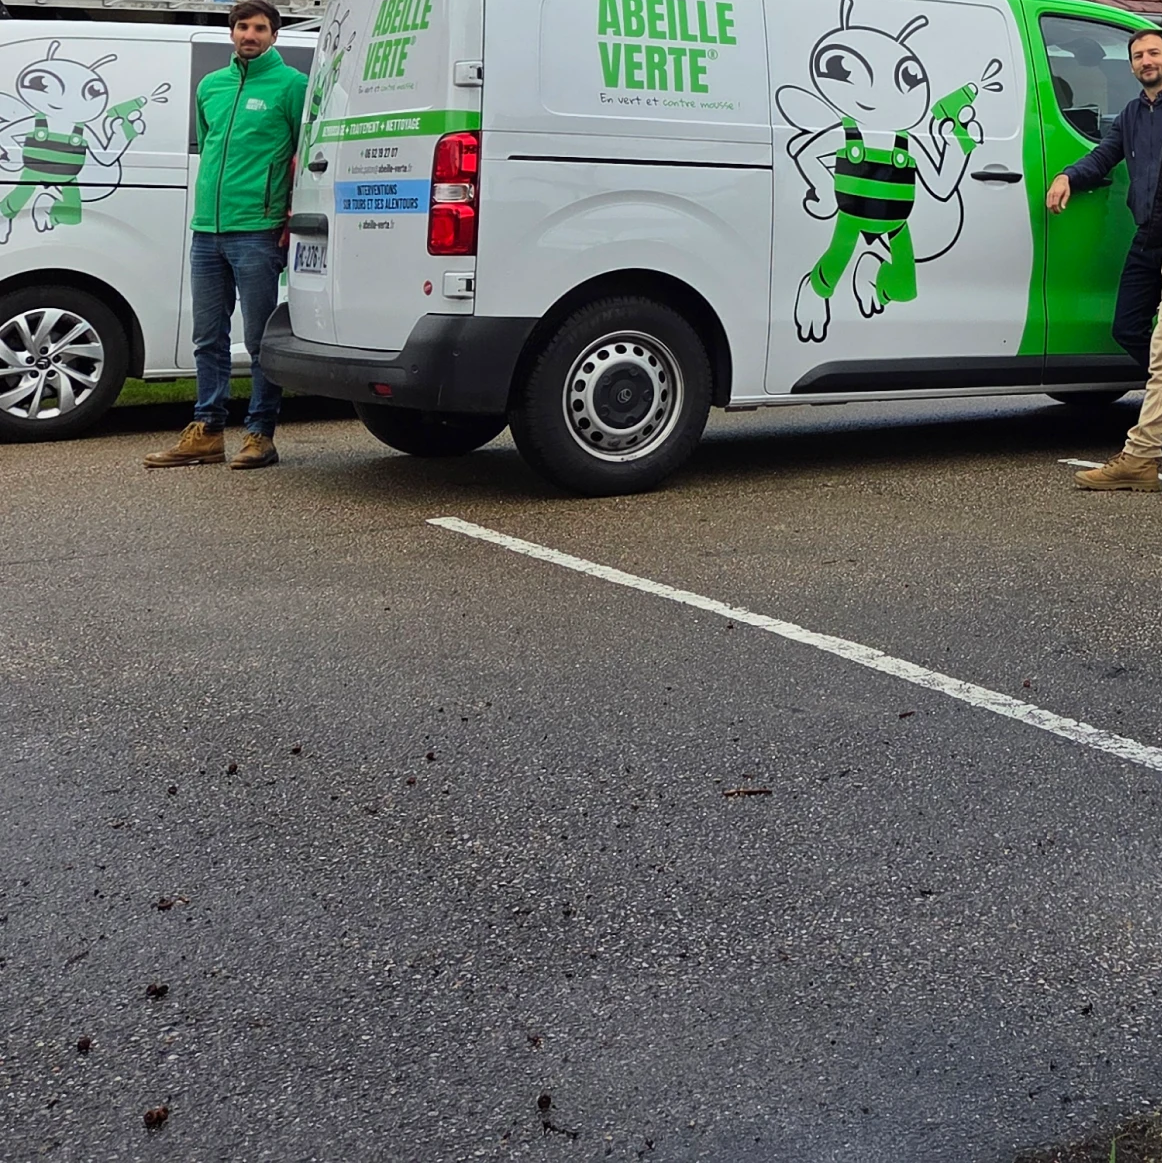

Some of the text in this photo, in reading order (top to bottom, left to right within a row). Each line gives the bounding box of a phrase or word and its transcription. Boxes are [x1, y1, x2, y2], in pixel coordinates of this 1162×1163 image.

[600, 92, 613, 104] En
[618, 95, 641, 106] vert
[646, 97, 659, 107] et
[662, 98, 696, 109] contre
[700, 100, 734, 111] mousse
[357, 184, 397, 195] INTERVENTIONS
[343, 198, 418, 209] SUR TOURS ET SES ALENTOURS
